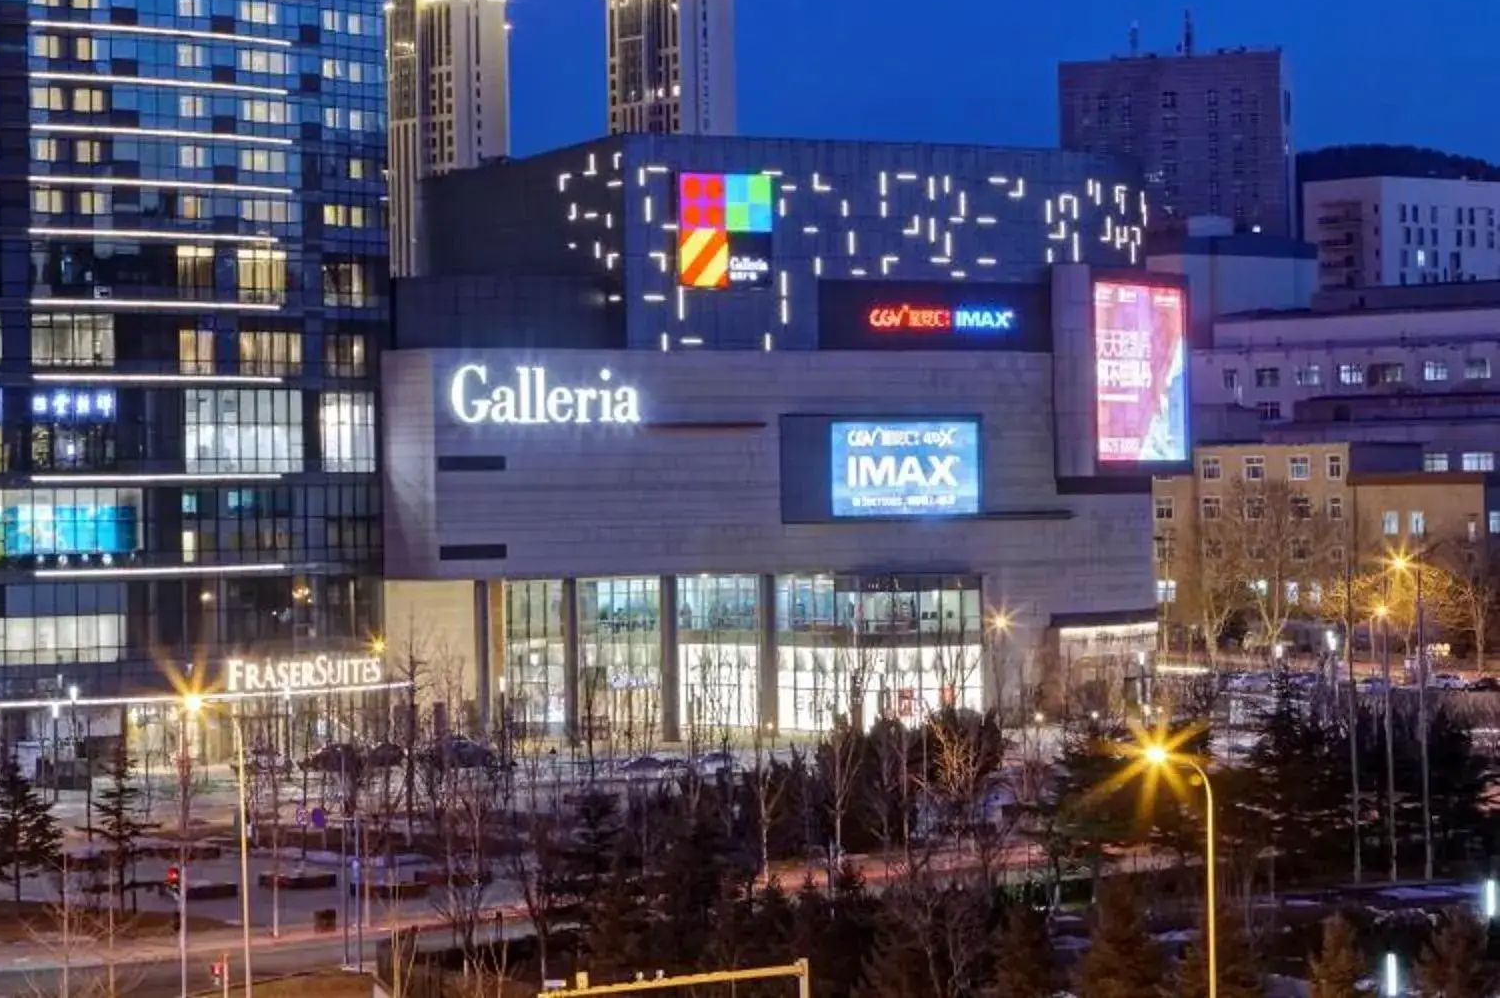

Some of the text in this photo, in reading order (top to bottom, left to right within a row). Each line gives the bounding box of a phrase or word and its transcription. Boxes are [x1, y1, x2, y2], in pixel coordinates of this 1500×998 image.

[956, 310, 1013, 329] IMAX
[451, 364, 641, 424] Galleria
[848, 455, 957, 488] IMAX
[228, 655, 381, 691] FRASERSUITES
